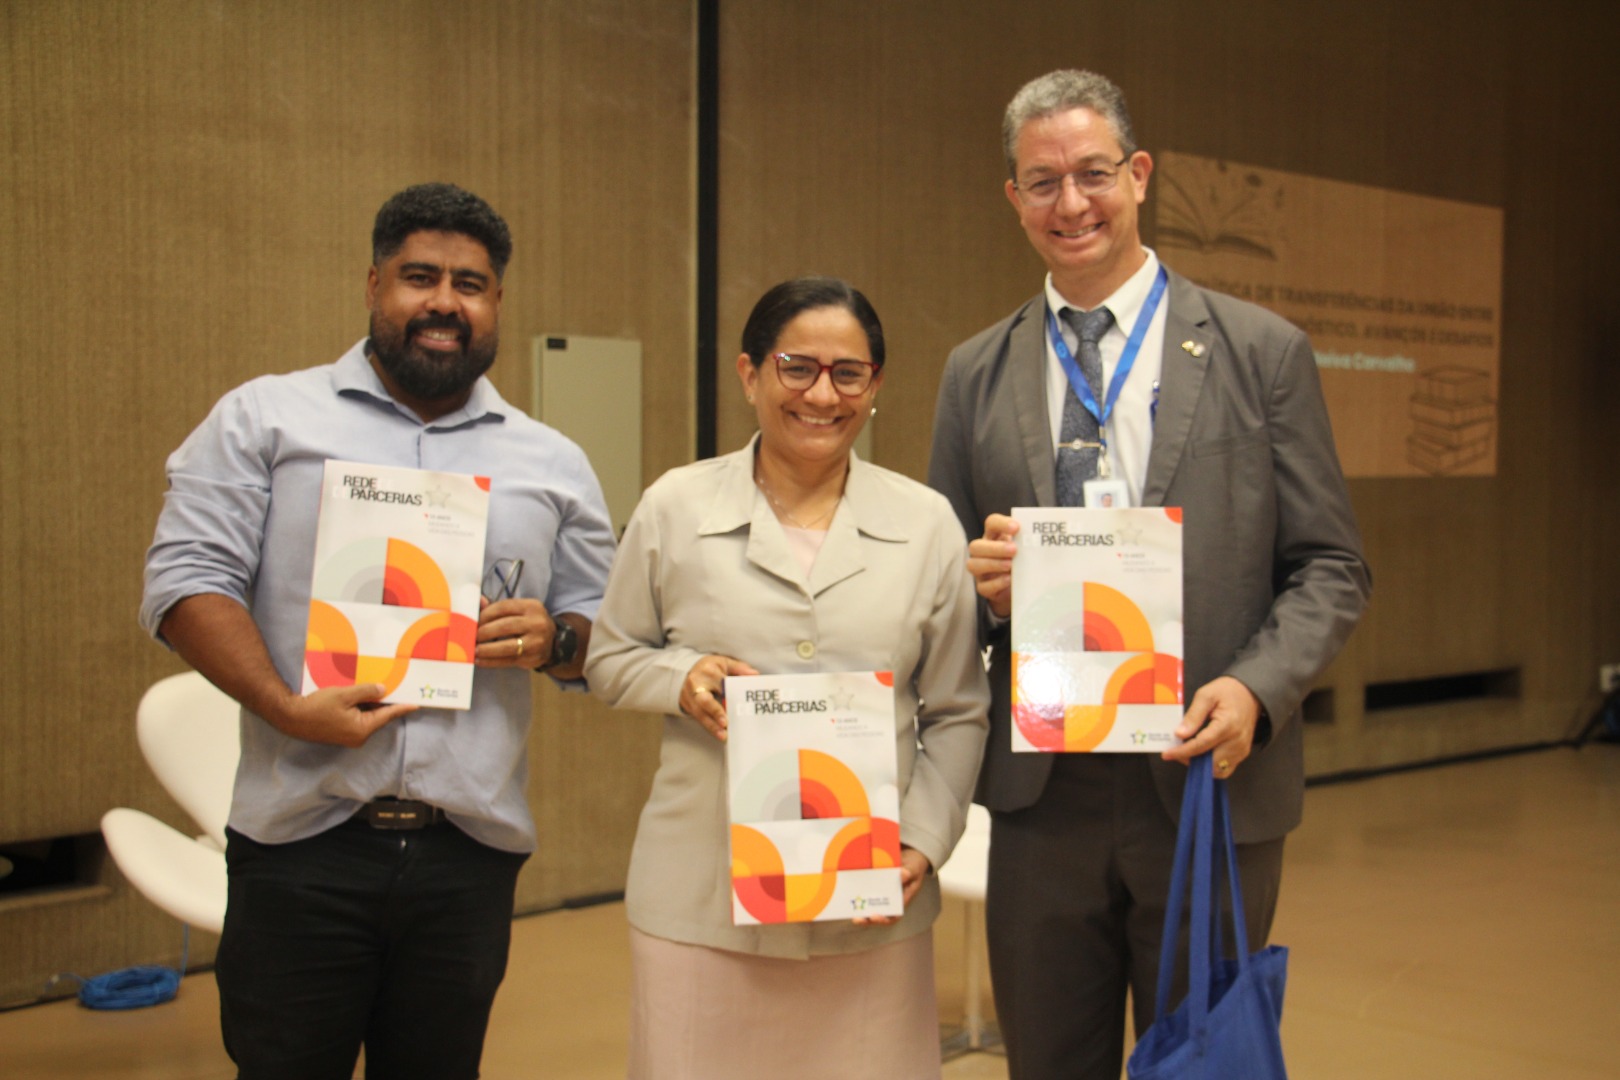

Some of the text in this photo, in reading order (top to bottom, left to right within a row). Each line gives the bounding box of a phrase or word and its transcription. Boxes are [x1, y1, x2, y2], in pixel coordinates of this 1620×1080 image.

[343, 474, 378, 489] REDE
[350, 488, 423, 506] PARCERIAS
[1032, 521, 1067, 534] REDE
[1041, 534, 1114, 547] PARCERIAS
[745, 689, 780, 702] REDE
[754, 700, 827, 715] PARCERIAS
